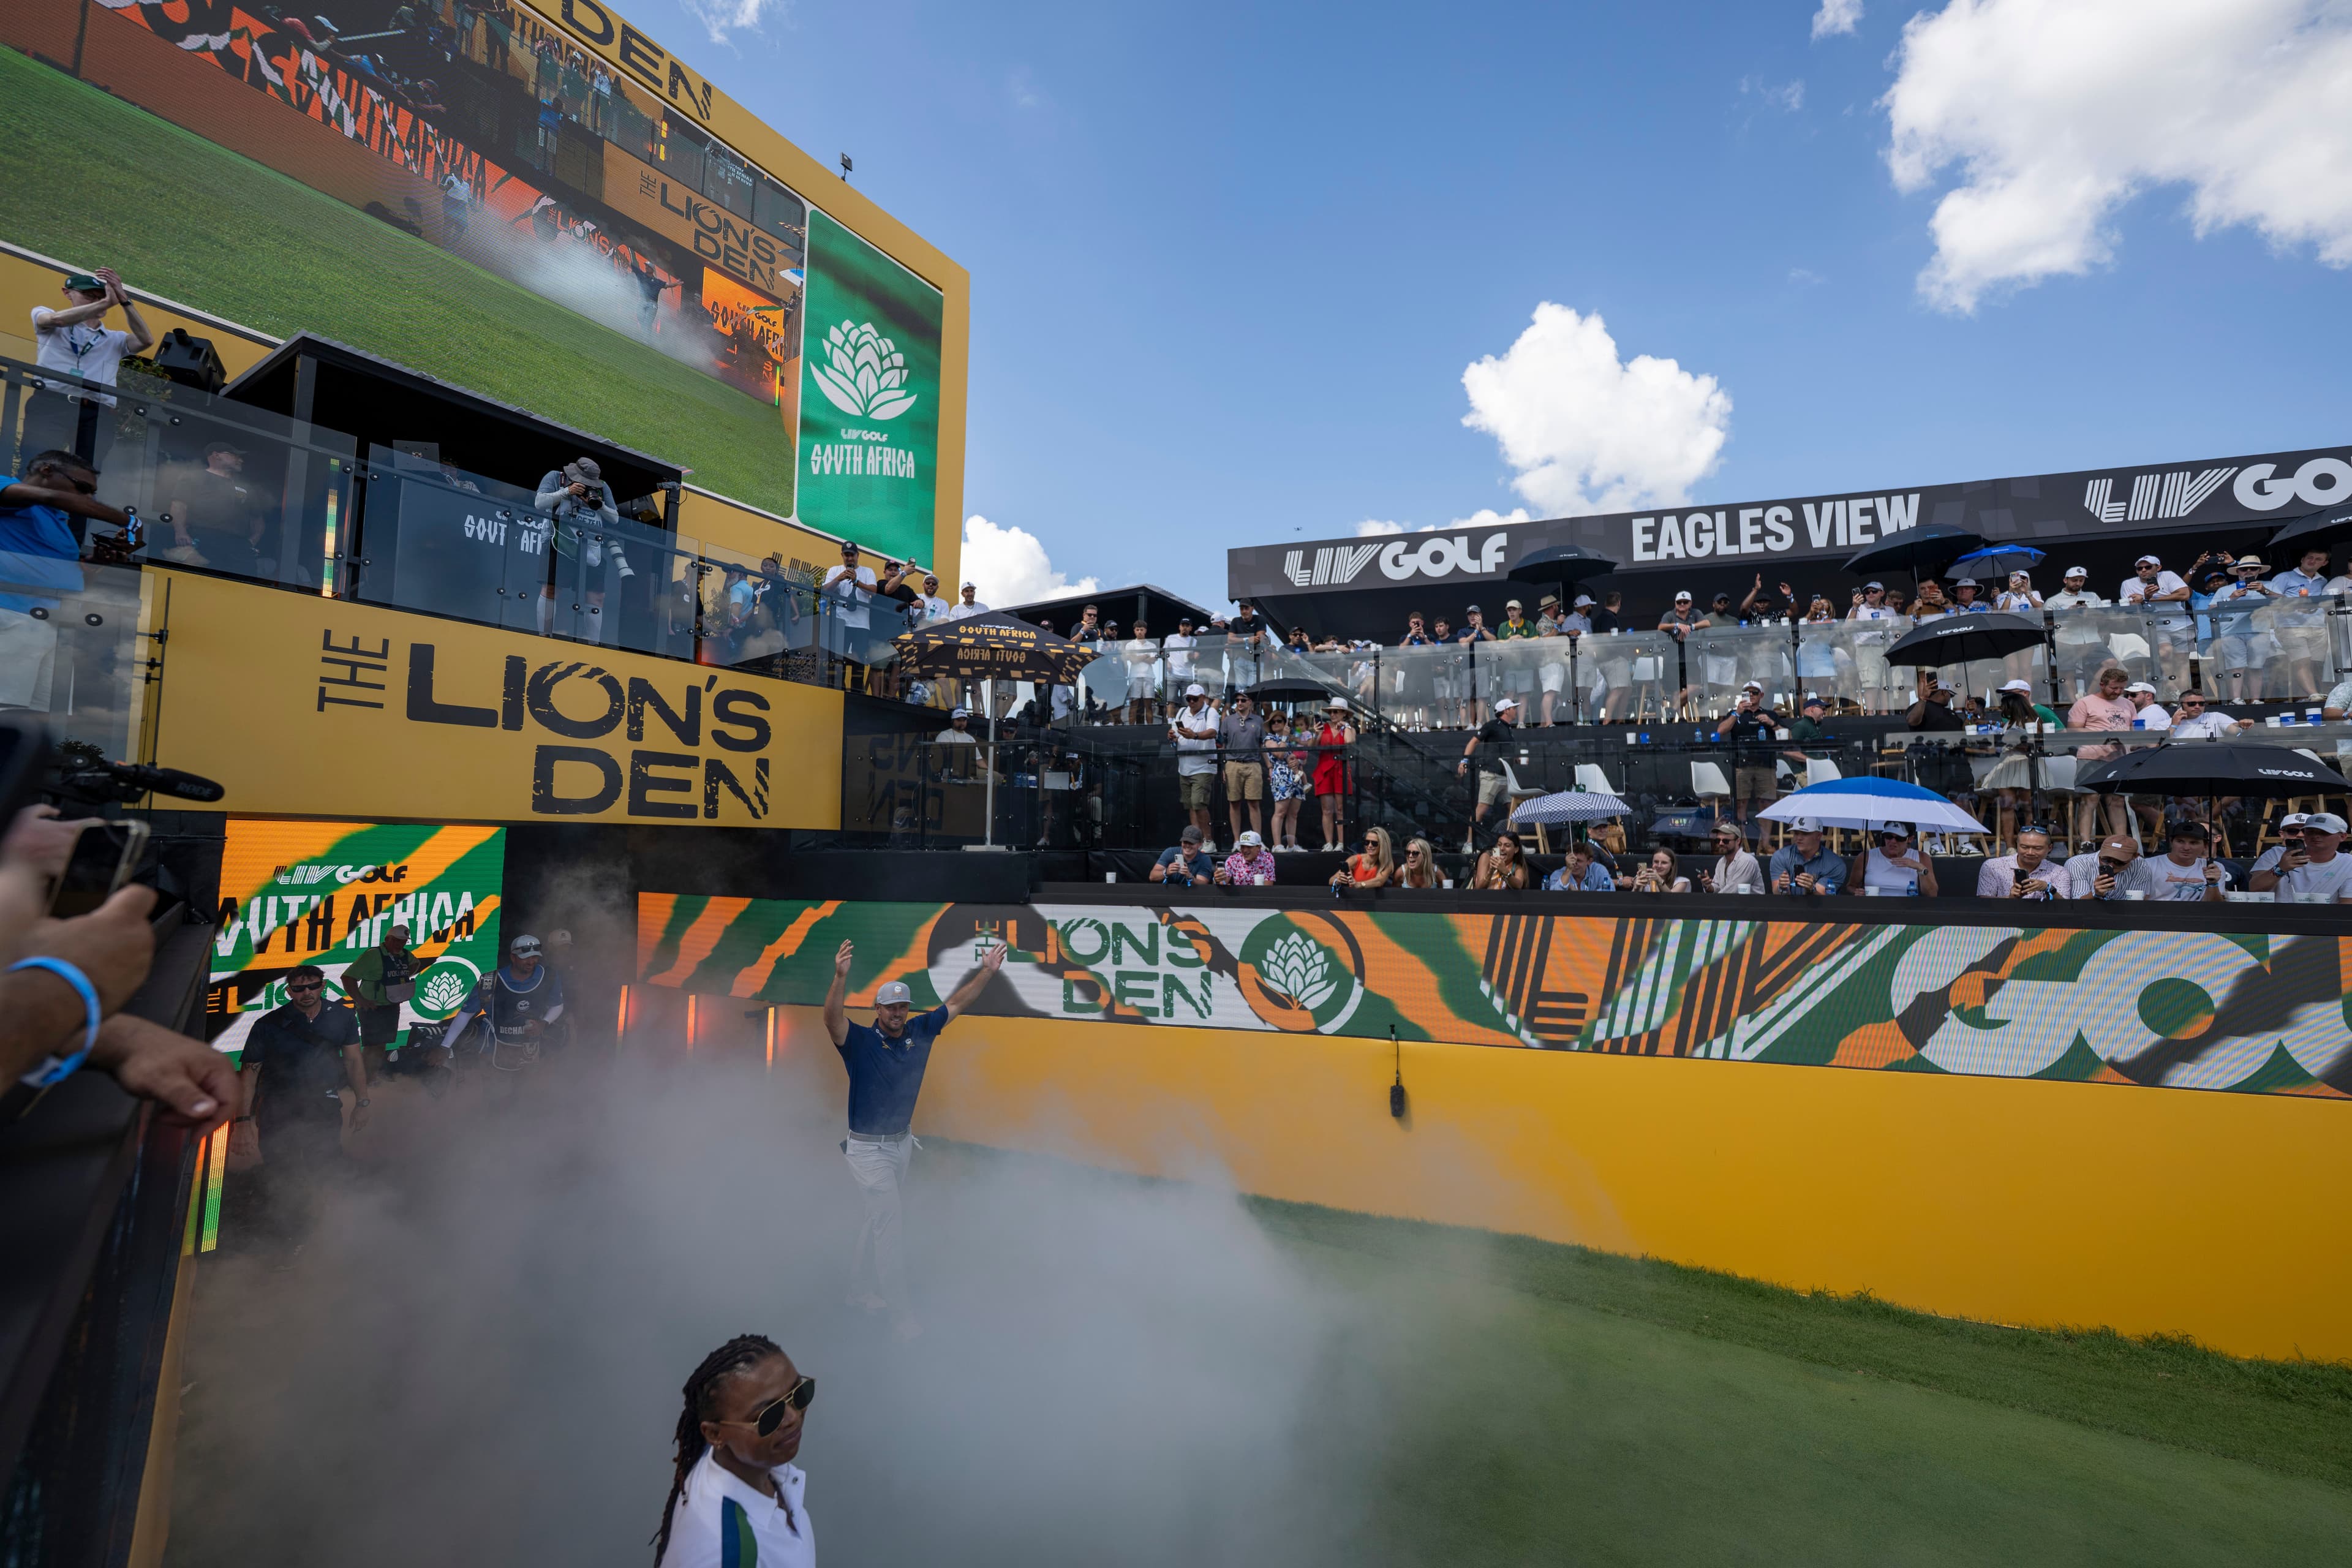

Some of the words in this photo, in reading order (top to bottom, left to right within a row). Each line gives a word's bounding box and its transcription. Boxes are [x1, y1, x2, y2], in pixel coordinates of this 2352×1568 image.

[561, 0, 712, 121] DEN
[639, 170, 657, 200] THE
[660, 182, 776, 265] LION'S
[693, 228, 775, 291] DEN
[754, 311, 777, 328] GOLF
[810, 444, 863, 475] SOUTH
[866, 446, 915, 478] AFRICA
[464, 514, 508, 546] SOUT
[1631, 505, 1794, 562] EAGLES
[1802, 493, 1921, 549] VIEW
[959, 625, 997, 636] SOUTH
[317, 628, 390, 712] THE
[406, 643, 772, 753] LION'S
[532, 745, 771, 820] DEN
[214, 895, 335, 957] OUTH
[345, 891, 475, 949] AFRICA
[1006, 913, 1212, 968] LION'S
[1063, 970, 1212, 1019] DEN
[499, 1026, 525, 1035] DECHA
